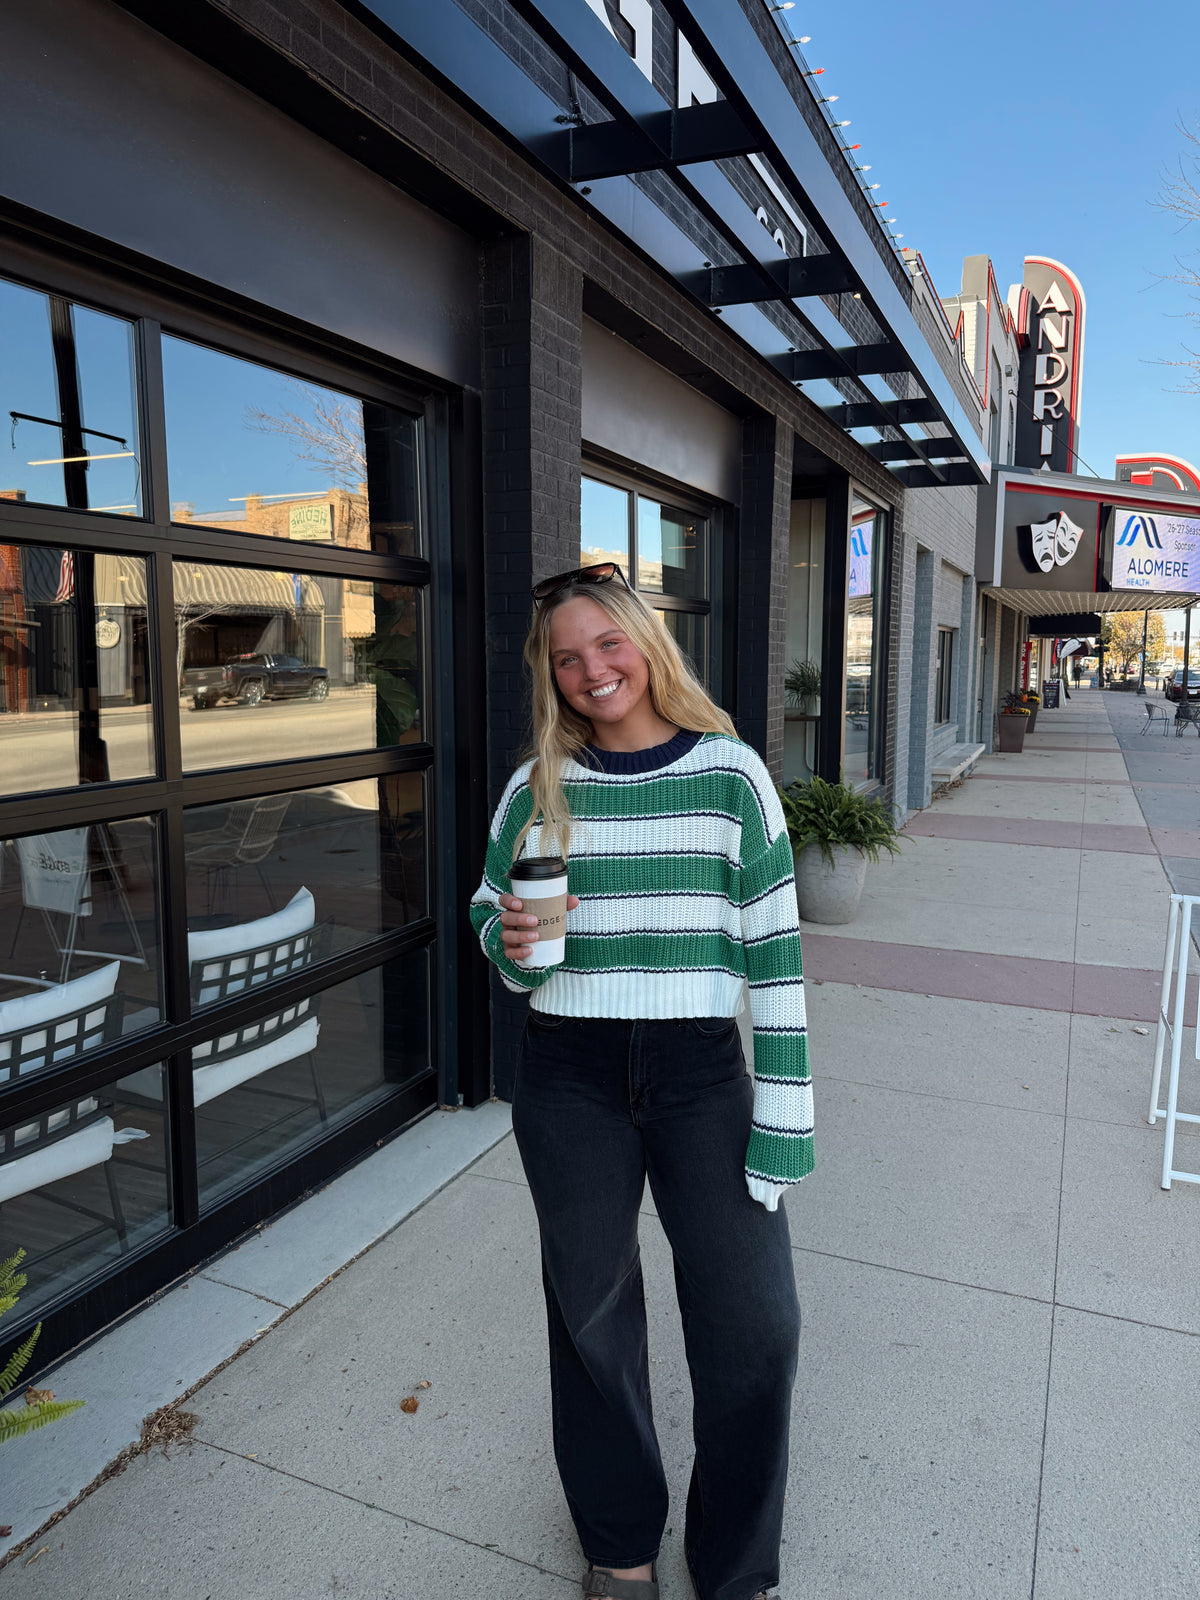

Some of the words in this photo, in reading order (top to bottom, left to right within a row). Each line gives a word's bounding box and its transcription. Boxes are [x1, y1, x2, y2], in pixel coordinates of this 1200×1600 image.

[1175, 540, 1196, 551] Sponsor
[1127, 558, 1189, 578] ALOMERE
[1126, 578, 1150, 587] HEALTH
